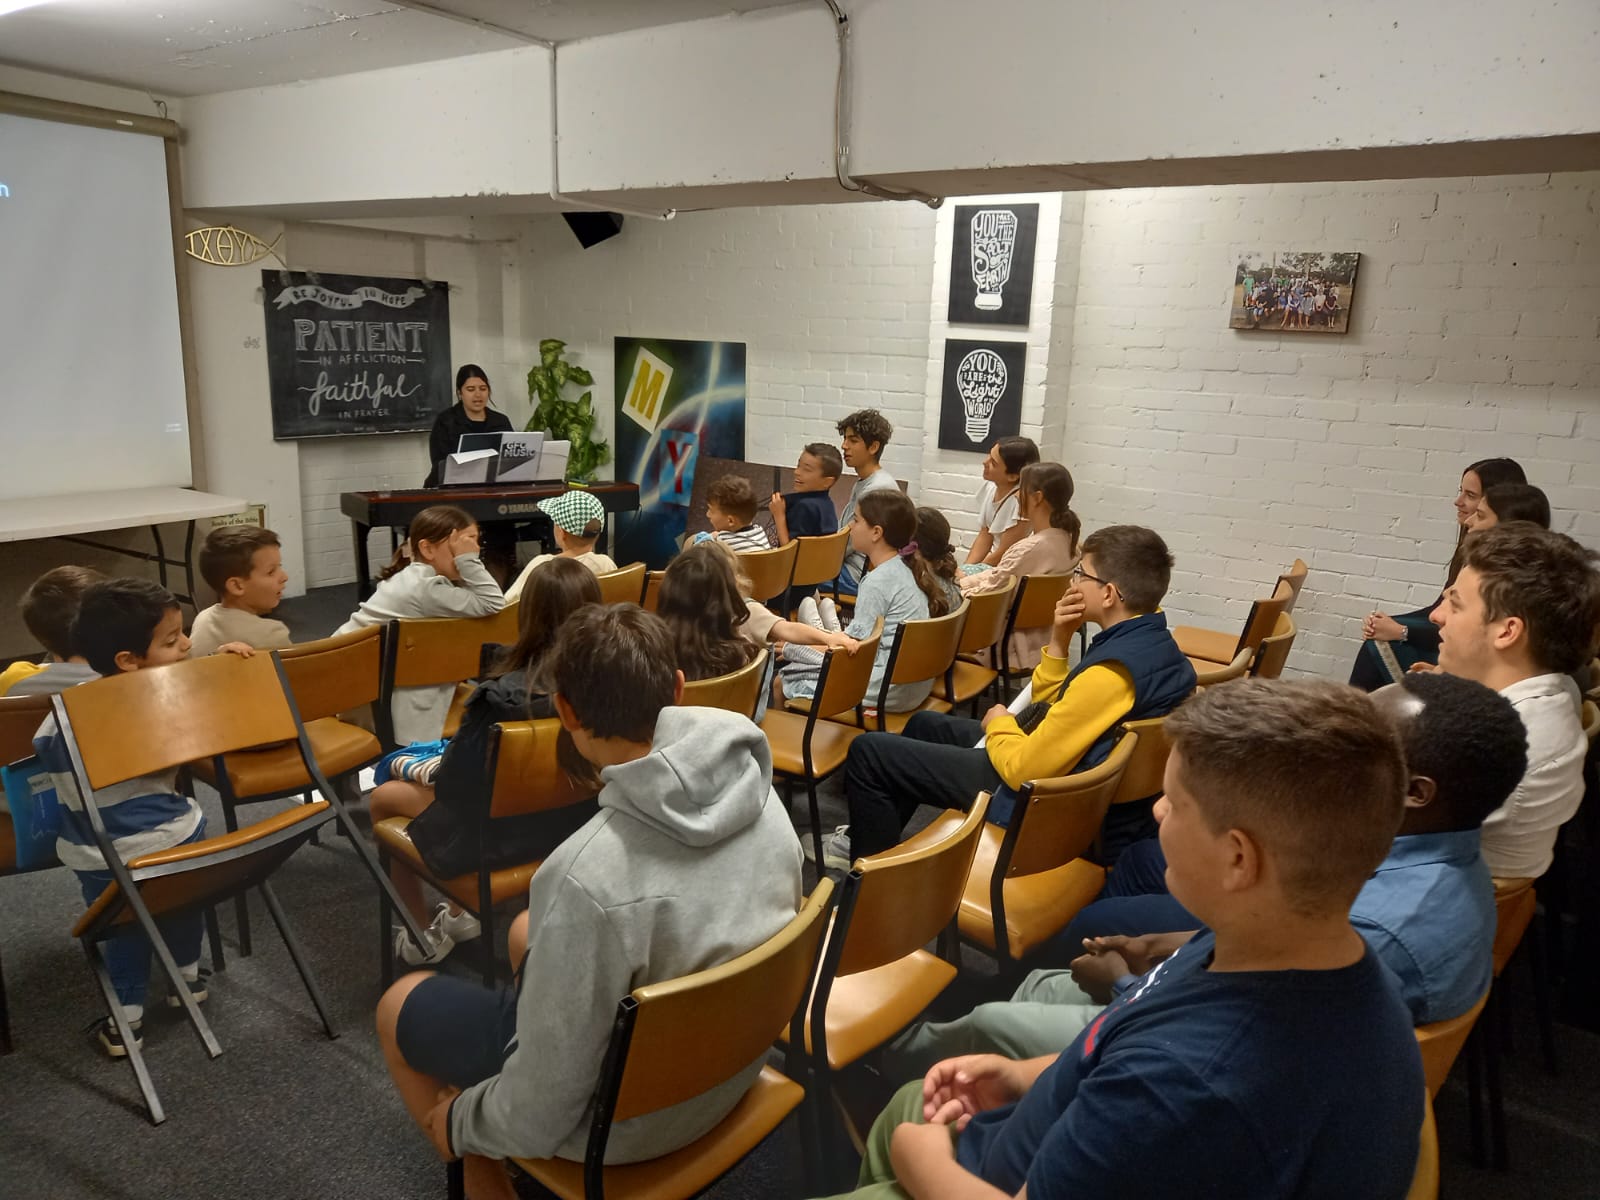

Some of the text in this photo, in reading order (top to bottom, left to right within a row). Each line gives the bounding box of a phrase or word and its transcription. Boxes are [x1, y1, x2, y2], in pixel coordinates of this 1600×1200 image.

[974, 241, 1011, 274] SALT
[292, 289, 306, 299] BE
[311, 287, 353, 307] JOYFUL
[381, 293, 407, 306] HOPE
[294, 319, 428, 352] PATIENT
[319, 354, 407, 367] IN AFFLICTION
[969, 352, 998, 373] YOU
[298, 371, 421, 416] faithful
[629, 359, 665, 422] M
[354, 408, 391, 419] PRAYER
[966, 398, 992, 416] WORLD
[504, 448, 536, 458] MUSIC
[506, 442, 527, 450] GFC
[666, 440, 693, 494] Y
